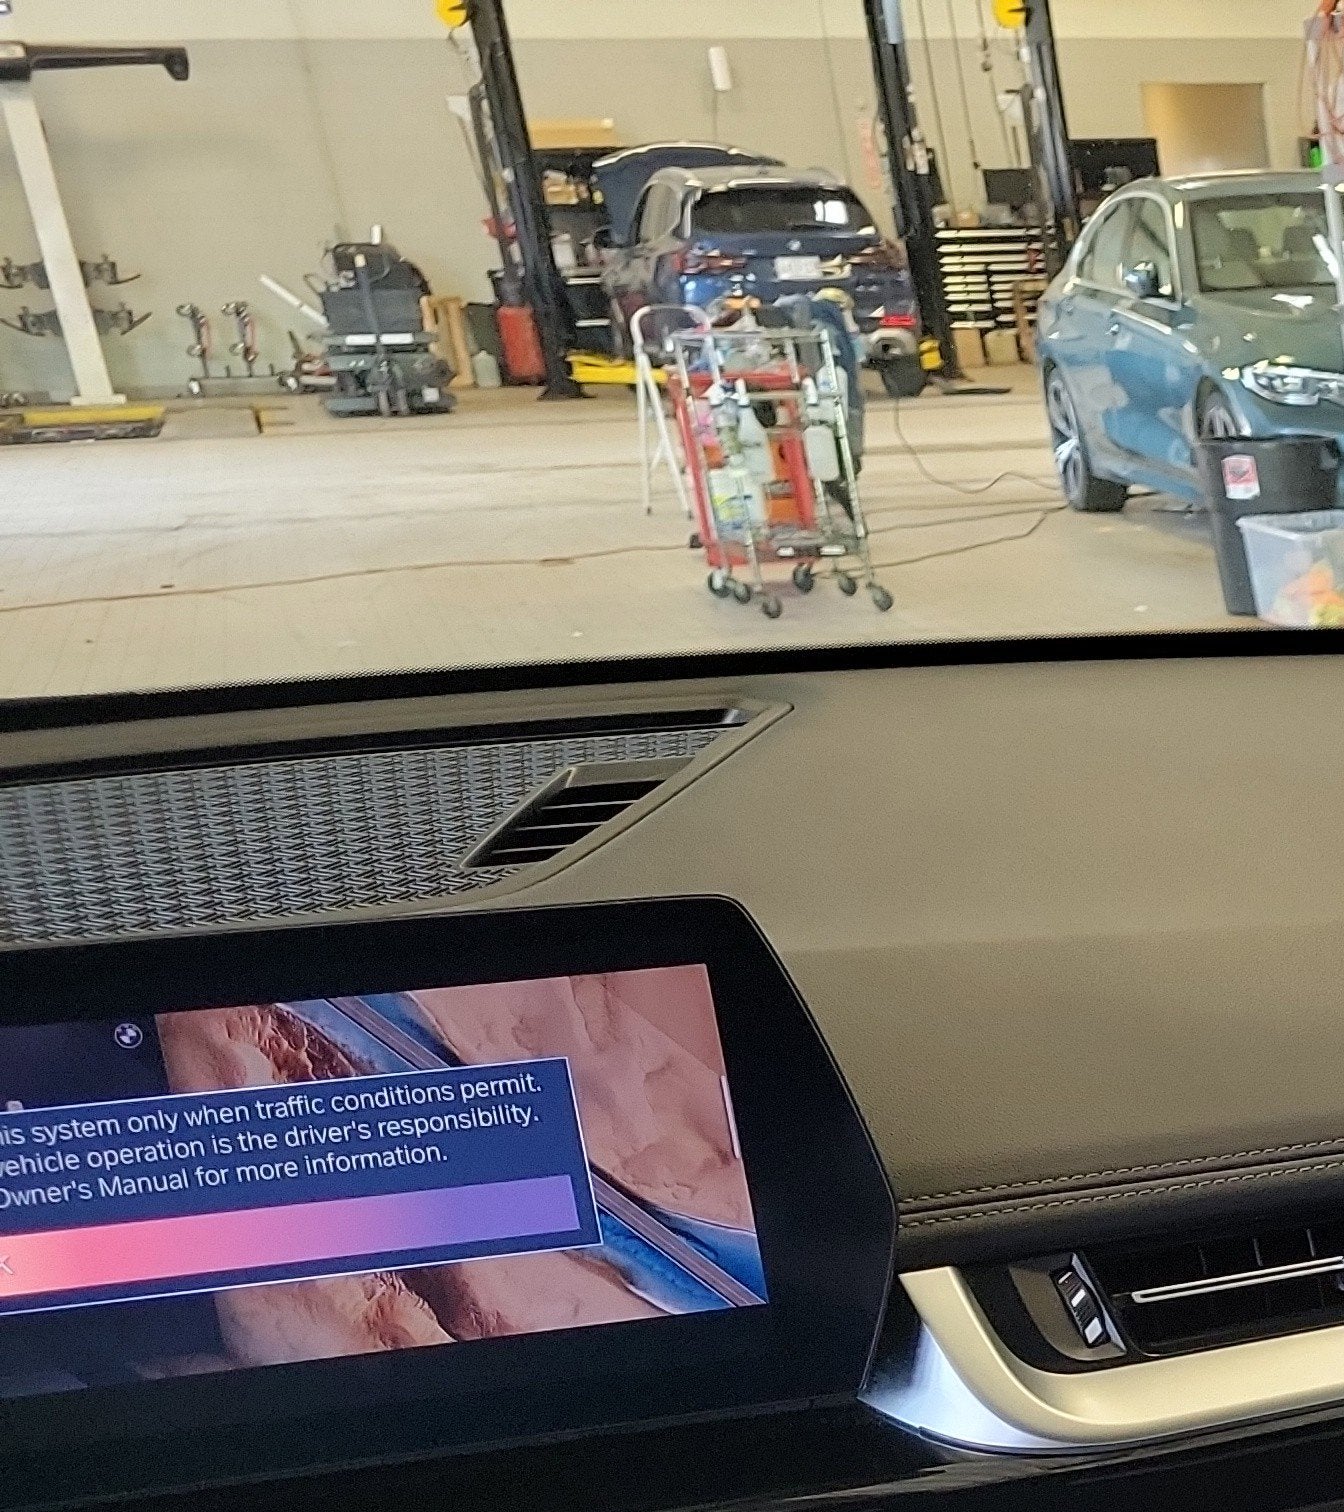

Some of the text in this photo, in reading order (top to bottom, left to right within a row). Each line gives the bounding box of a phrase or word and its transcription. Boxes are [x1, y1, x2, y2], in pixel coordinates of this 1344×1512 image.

[32, 1117, 121, 1146] system
[128, 1109, 178, 1134] only
[184, 1104, 250, 1127] when
[255, 1095, 325, 1121] traffic
[331, 1083, 455, 1113] conditions
[461, 1072, 542, 1102] permit.
[87, 1138, 205, 1170] operation
[212, 1134, 233, 1155] is
[238, 1130, 278, 1151] the
[285, 1120, 372, 1148] driver's
[378, 1103, 540, 1139] responsibility.
[0, 1144, 448, 1209] Owner's Manual for more information.
